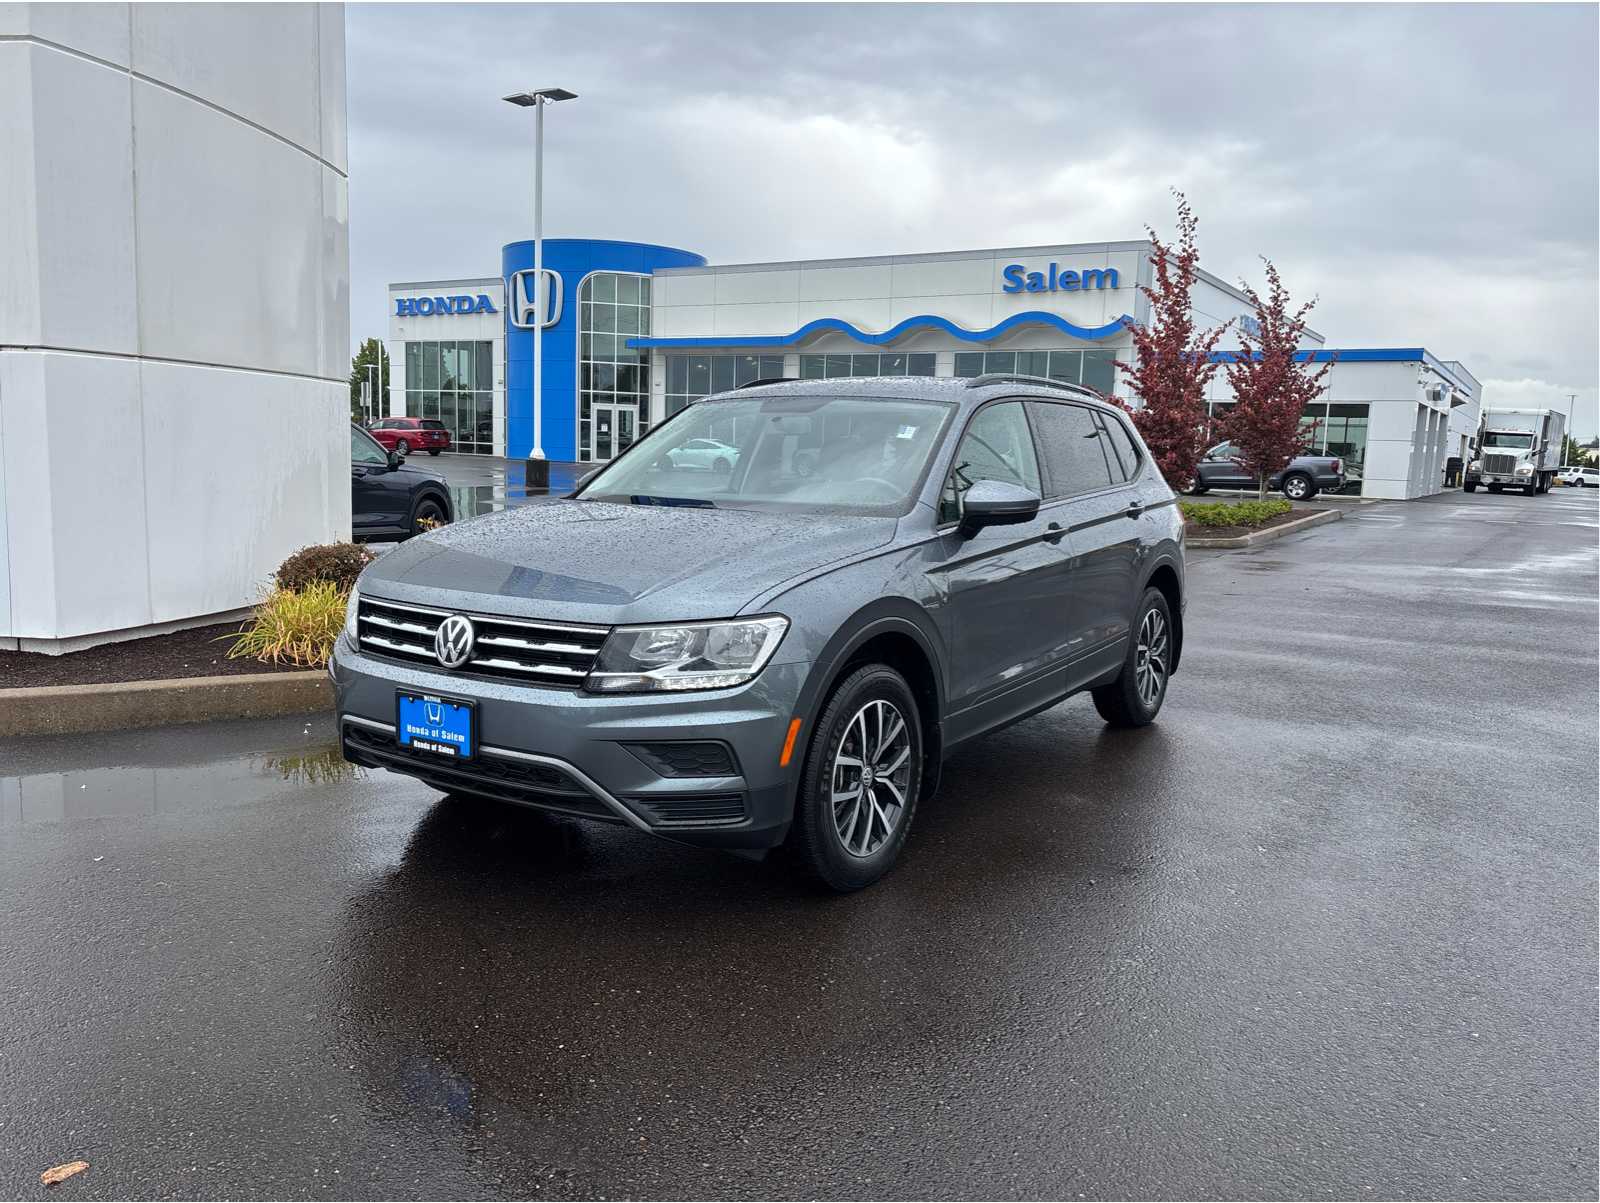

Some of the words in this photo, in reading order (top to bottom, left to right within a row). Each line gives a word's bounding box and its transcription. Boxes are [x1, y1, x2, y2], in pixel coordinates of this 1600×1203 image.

[1002, 262, 1119, 293] Salem
[395, 294, 498, 317] HONDA
[407, 723, 429, 736] Honda
[431, 729, 439, 738] of
[441, 730, 465, 743] Salem
